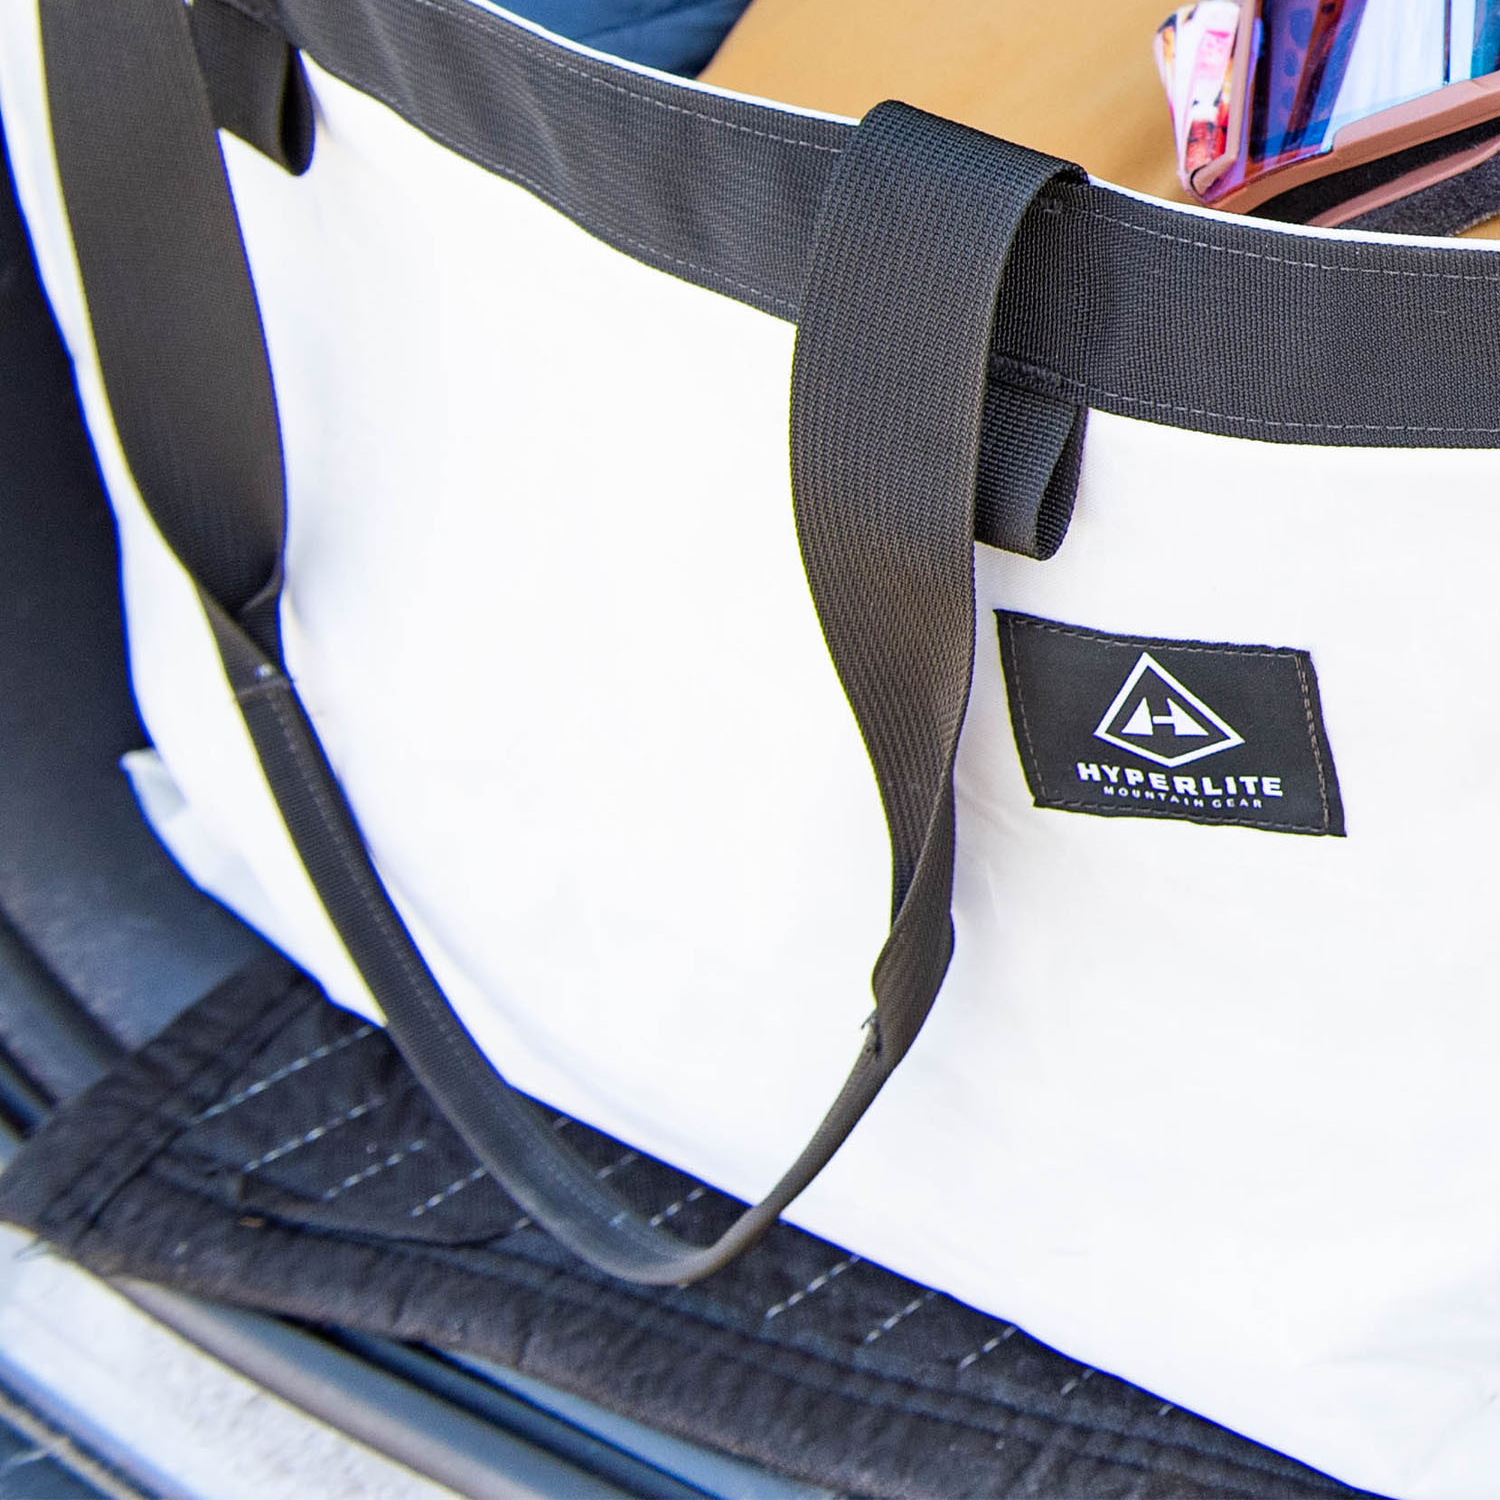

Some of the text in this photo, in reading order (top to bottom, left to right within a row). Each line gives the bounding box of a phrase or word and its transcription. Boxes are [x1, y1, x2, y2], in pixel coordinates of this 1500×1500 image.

[1075, 762, 1284, 798] HYPERLITE
[1103, 785, 1263, 810] MOUNTAIN GEAR
